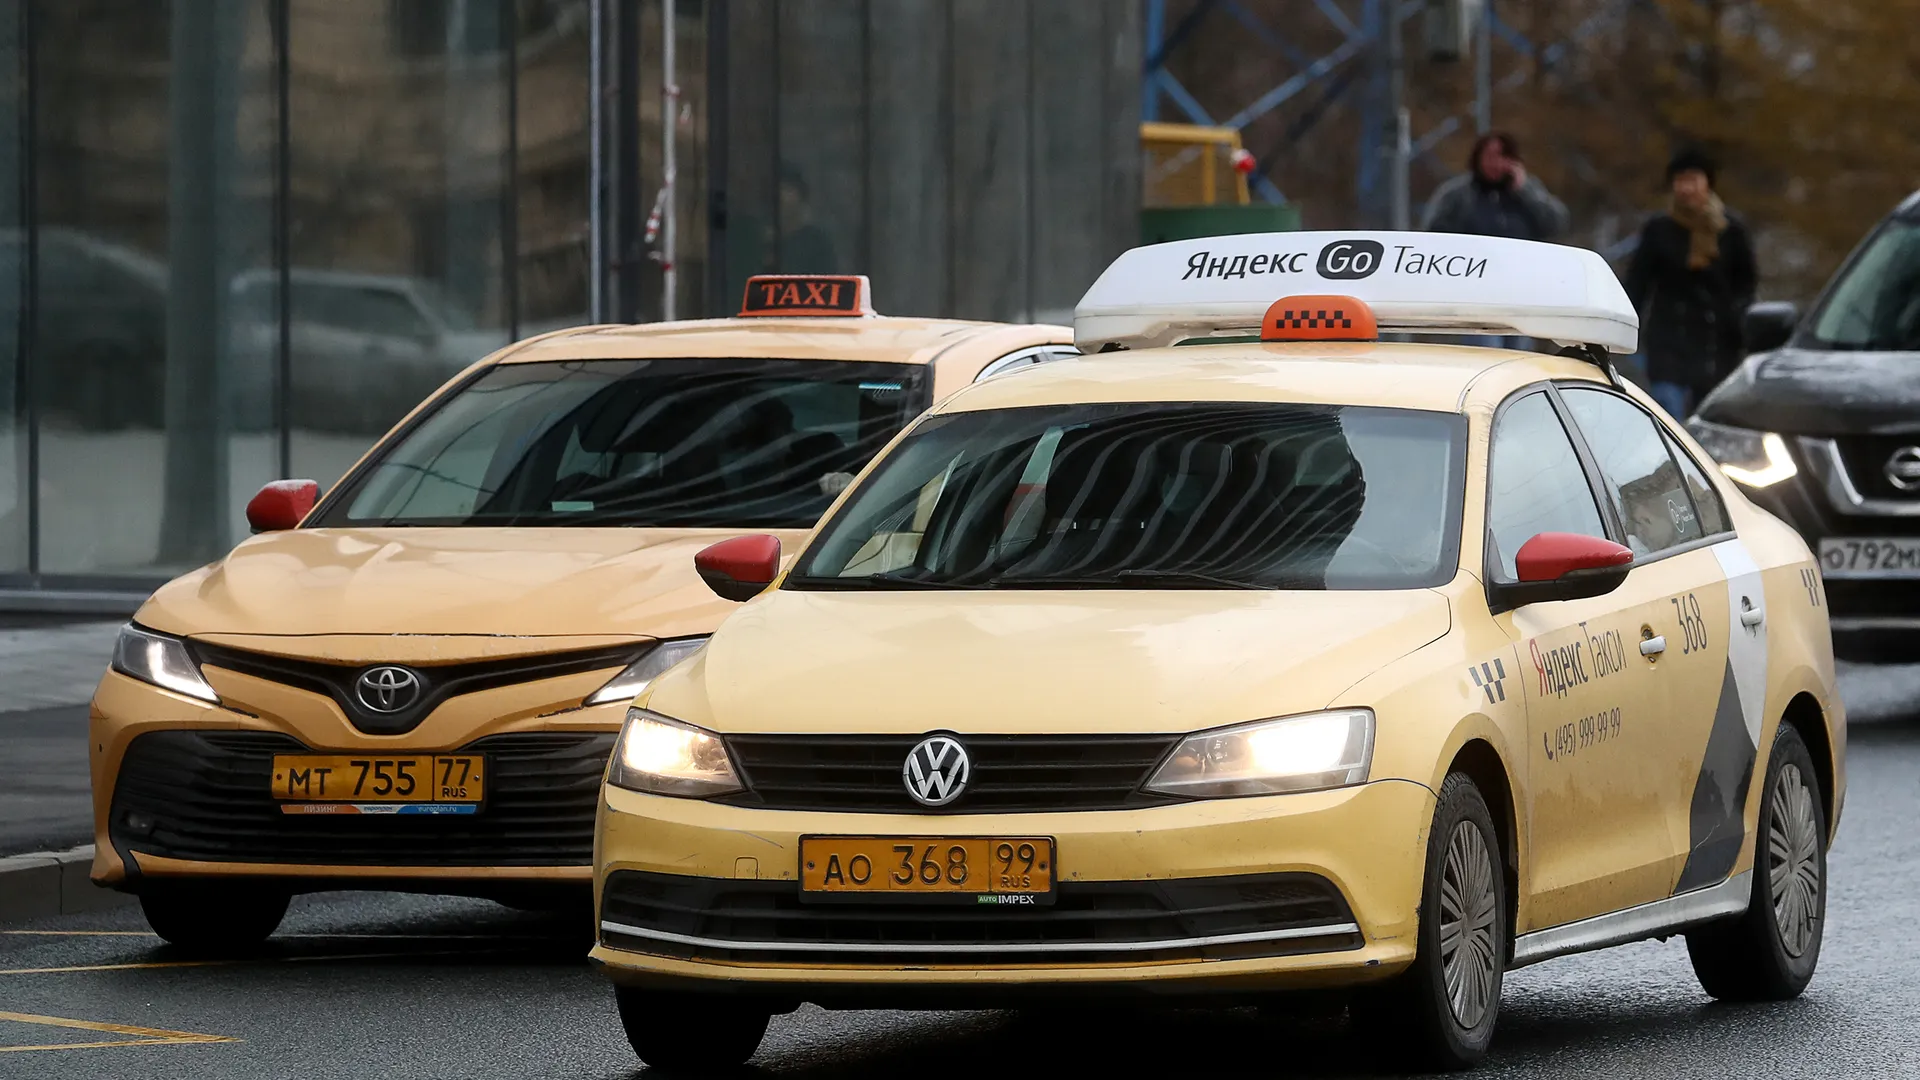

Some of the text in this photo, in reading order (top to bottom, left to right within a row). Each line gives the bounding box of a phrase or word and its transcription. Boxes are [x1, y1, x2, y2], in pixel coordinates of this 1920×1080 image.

[1181, 244, 1488, 280] Яндекс Go Такси
[761, 282, 841, 306] TAXI
[1823, 541, 1920, 570] О792М
[1671, 593, 1707, 655] 368
[1529, 621, 1627, 699] Яндекс Такси
[1555, 707, 1620, 762] (495) 999 99 99
[350, 760, 417, 796] 755
[438, 758, 472, 787] 77
[442, 787, 468, 798] RUS
[891, 844, 969, 886] 368
[996, 842, 1037, 875] 99
[1001, 875, 1031, 888] RUS
[979, 894, 1035, 904] AUTO IMPEX
